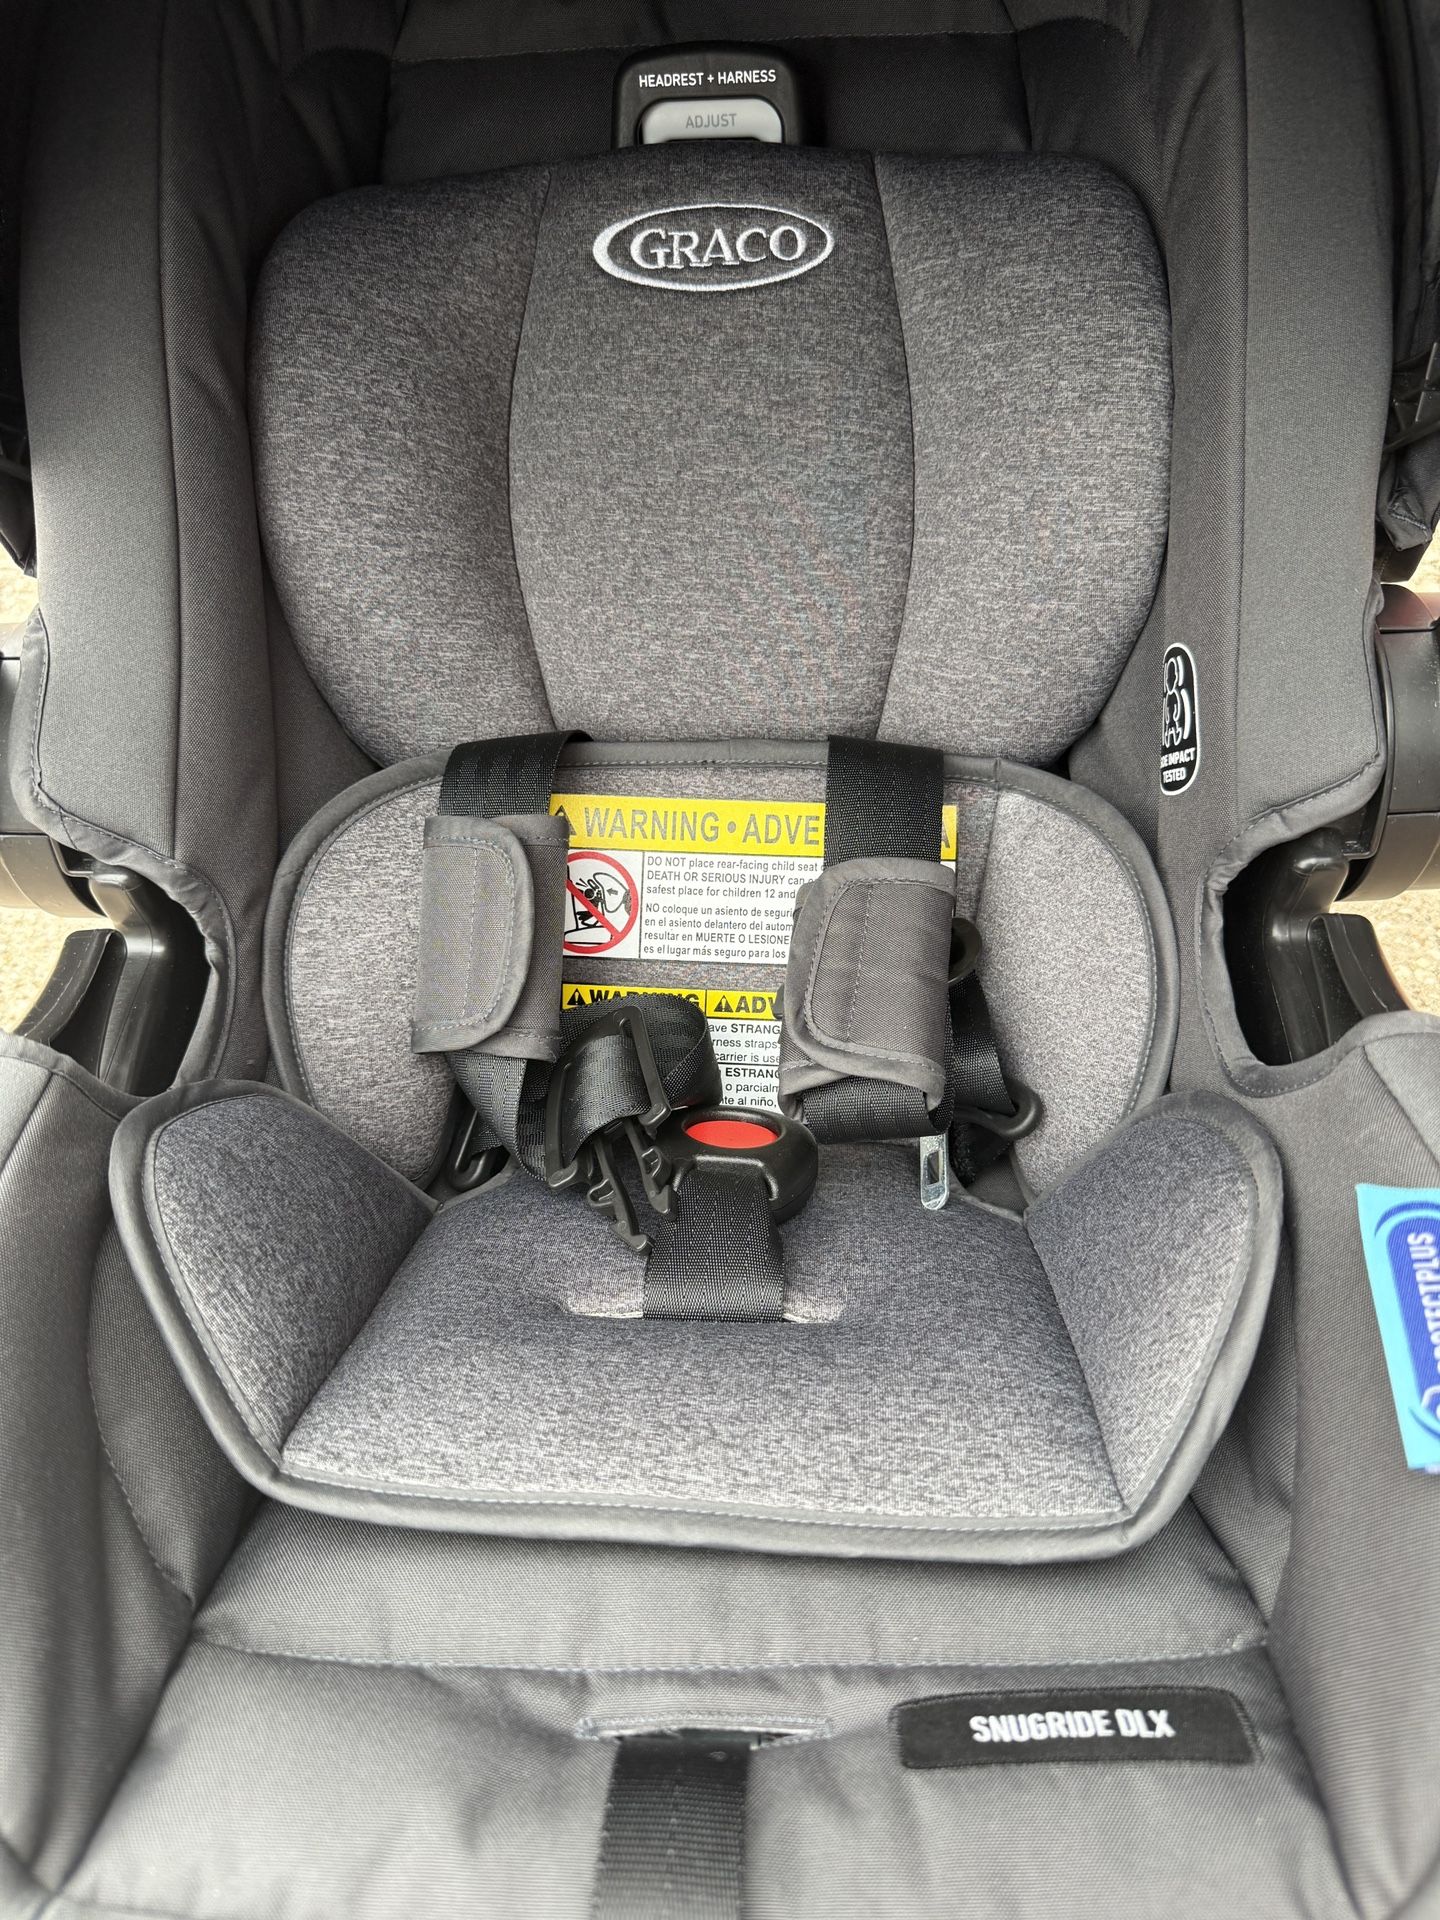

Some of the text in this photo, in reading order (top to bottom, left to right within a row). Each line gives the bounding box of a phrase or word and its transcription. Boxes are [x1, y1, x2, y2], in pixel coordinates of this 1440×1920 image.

[639, 70, 776, 87] HEADREST + HARNESS
[685, 113, 738, 129] ADJUST
[630, 225, 806, 269] GRACO
[1168, 747, 1196, 765] IMPACT
[1162, 767, 1187, 784] TESTED
[584, 806, 820, 846] WARNING ADVE
[647, 856, 662, 866] DO
[665, 857, 686, 867] NOT
[689, 858, 714, 870] place
[717, 860, 769, 872] rear-facing
[772, 860, 795, 872] child
[798, 863, 818, 872] seat
[647, 870, 680, 881] DEATH
[684, 872, 698, 882] OR
[701, 872, 746, 884] SERIOUS
[749, 874, 785, 885] INJURY
[788, 877, 805, 885] can
[646, 884, 796, 899] safest place for children 12 and
[646, 903, 793, 919] NO coloque un asiento de seguri
[644, 917, 794, 931] en el asiento delantero del autom
[644, 932, 680, 941] resultar
[696, 932, 736, 943] MUERTE
[738, 934, 746, 944] O
[748, 934, 790, 945] LESIONE
[644, 944, 786, 959] es el lugar más seguro para los
[708, 1024, 780, 1034] ave STRANG
[713, 1040, 742, 1048] rness
[716, 1052, 780, 1063] carrier is use
[726, 1068, 780, 1078] ESTRANG
[725, 1083, 779, 1093] o parcialm
[721, 1096, 777, 1108] te al niño,
[1407, 1232, 1440, 1374] ECTPLUS
[969, 1708, 1176, 1742] SNUGRIDE DLX
